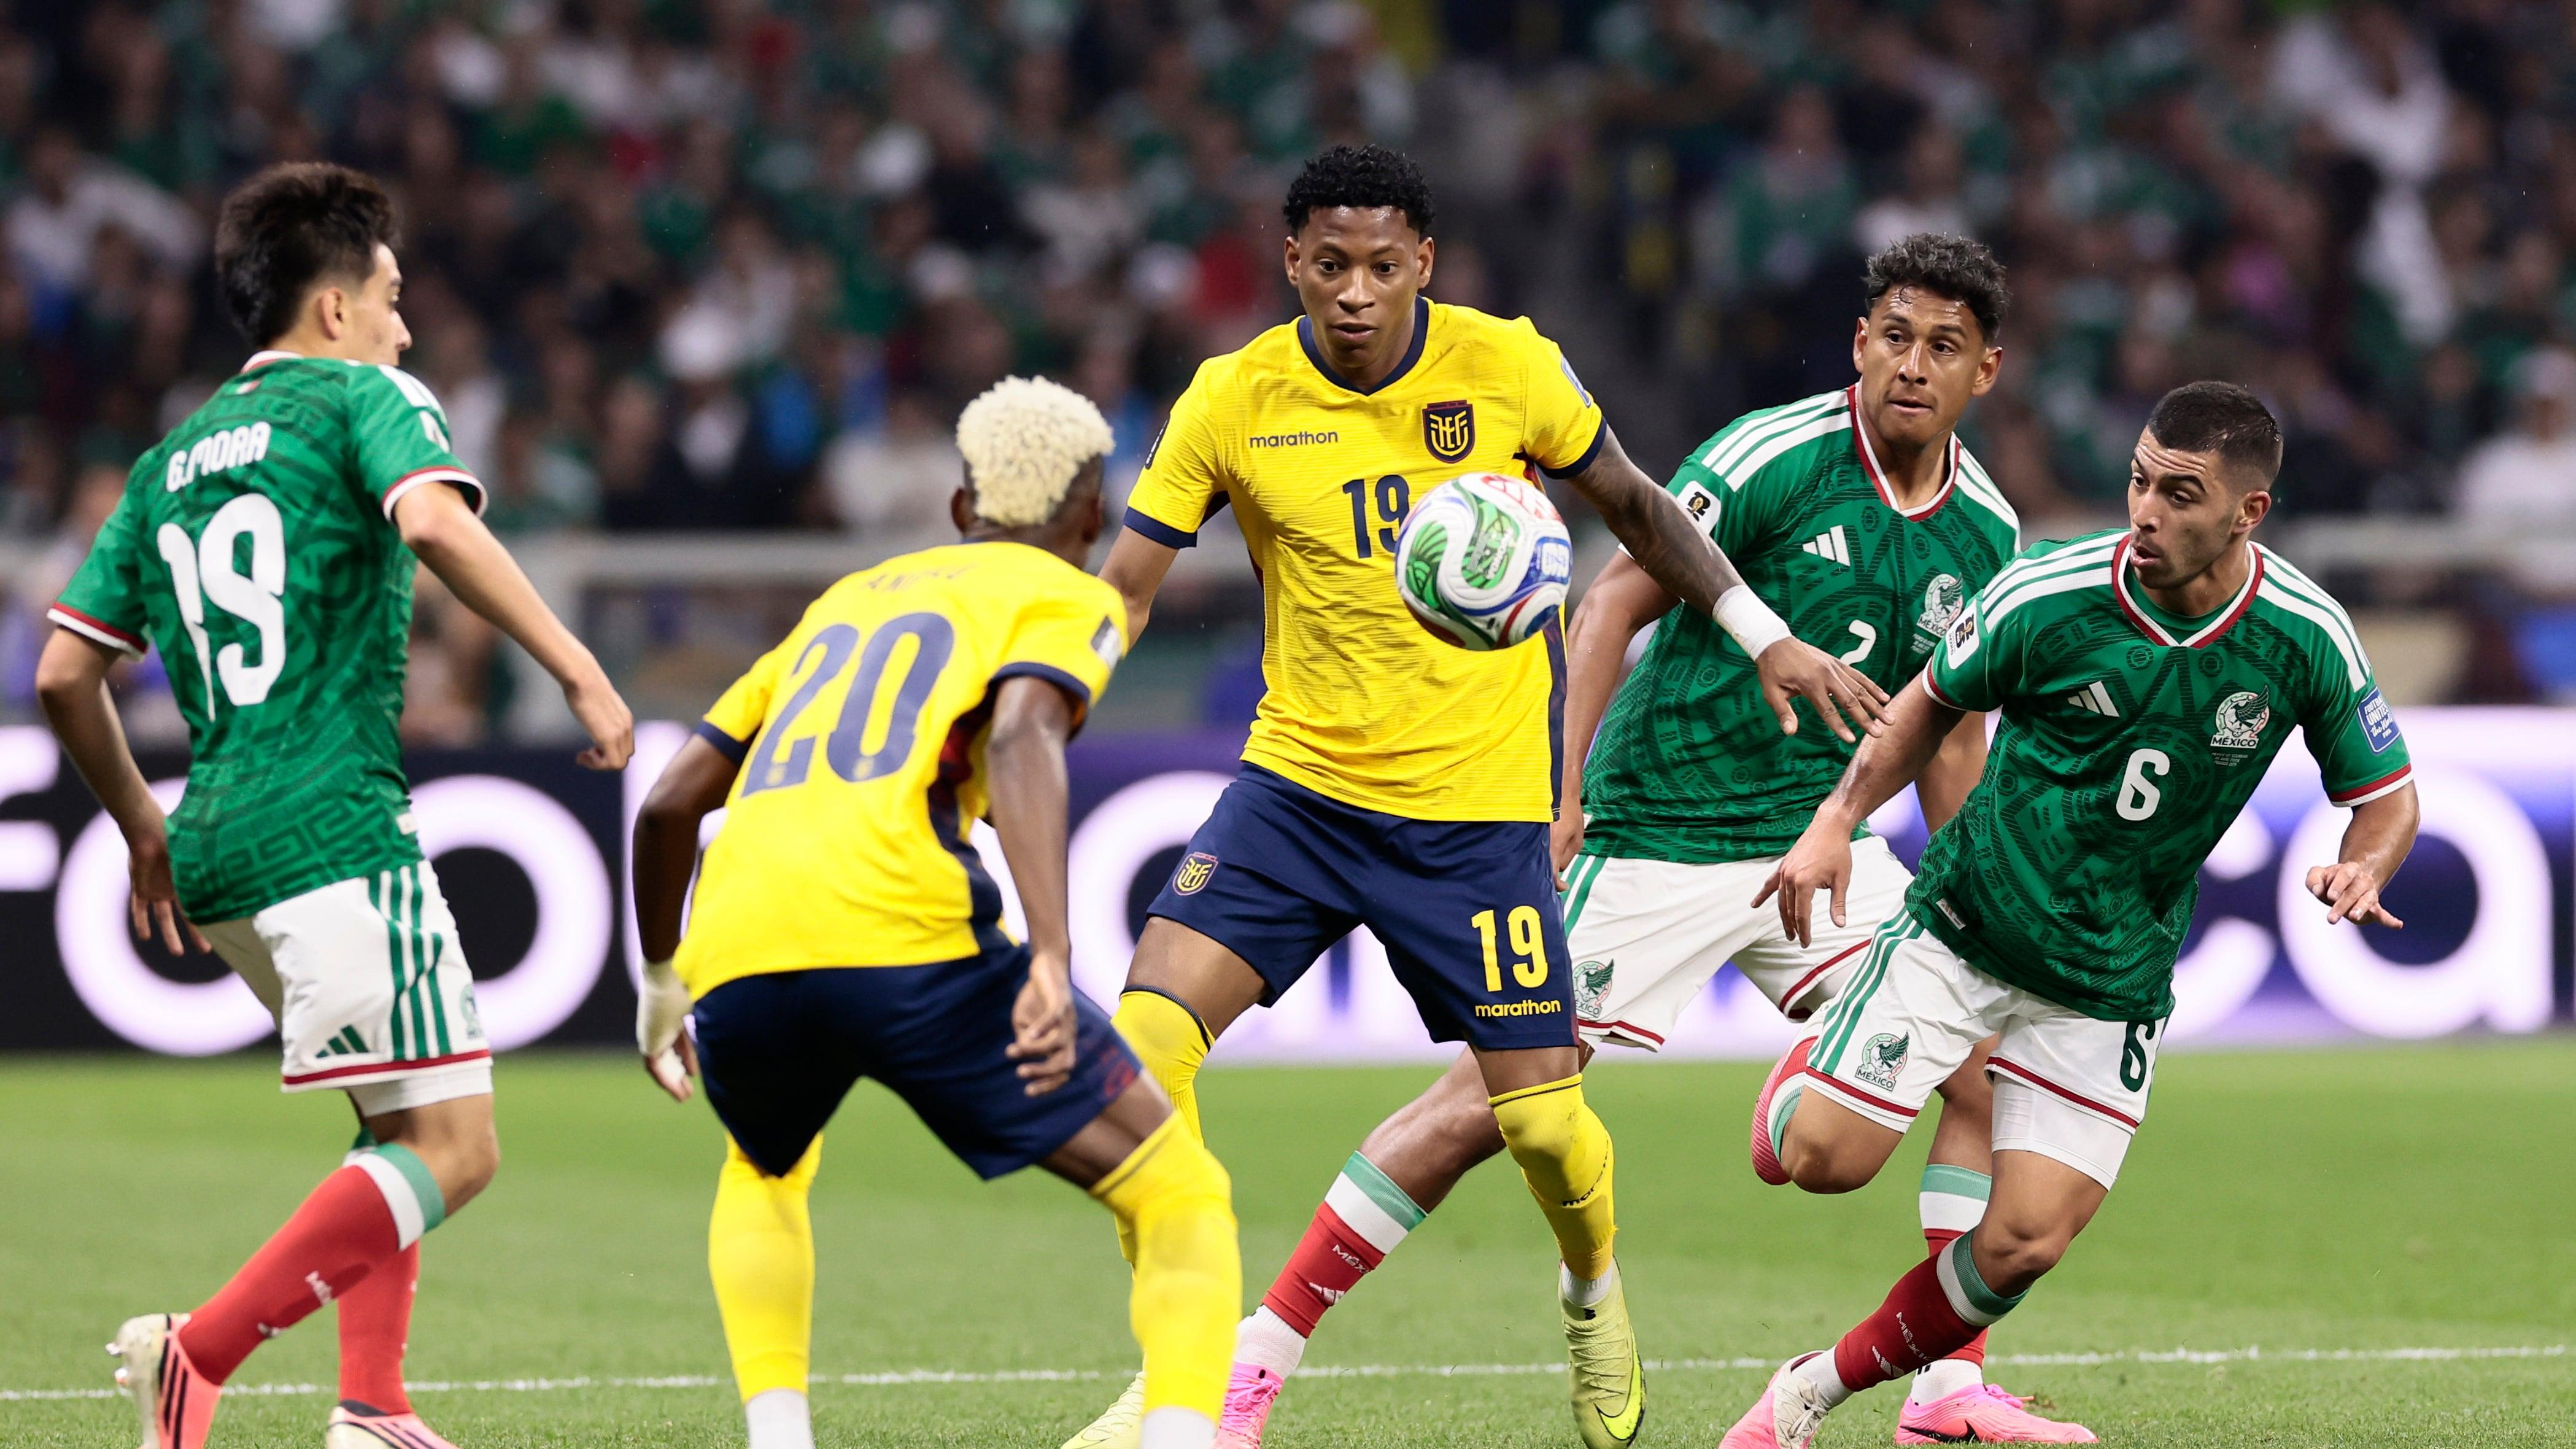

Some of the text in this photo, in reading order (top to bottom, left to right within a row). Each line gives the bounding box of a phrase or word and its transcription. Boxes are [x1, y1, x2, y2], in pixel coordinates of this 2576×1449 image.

[166, 421, 271, 492] G.MORA
[1249, 431, 1339, 448] marathon
[1342, 474, 1410, 559] 19
[157, 493, 286, 724] 19
[1839, 620, 1876, 667] 2
[1918, 616, 1947, 636] MÉXICO
[740, 612, 954, 799] 20
[2212, 736, 2256, 747] MÉXICO
[2116, 748, 2170, 821] 6
[1471, 904, 1549, 993] 19
[1474, 999, 1561, 1017] marathon
[1857, 1069, 1893, 1089] MÉXICO
[2120, 1020, 2156, 1092] 6
